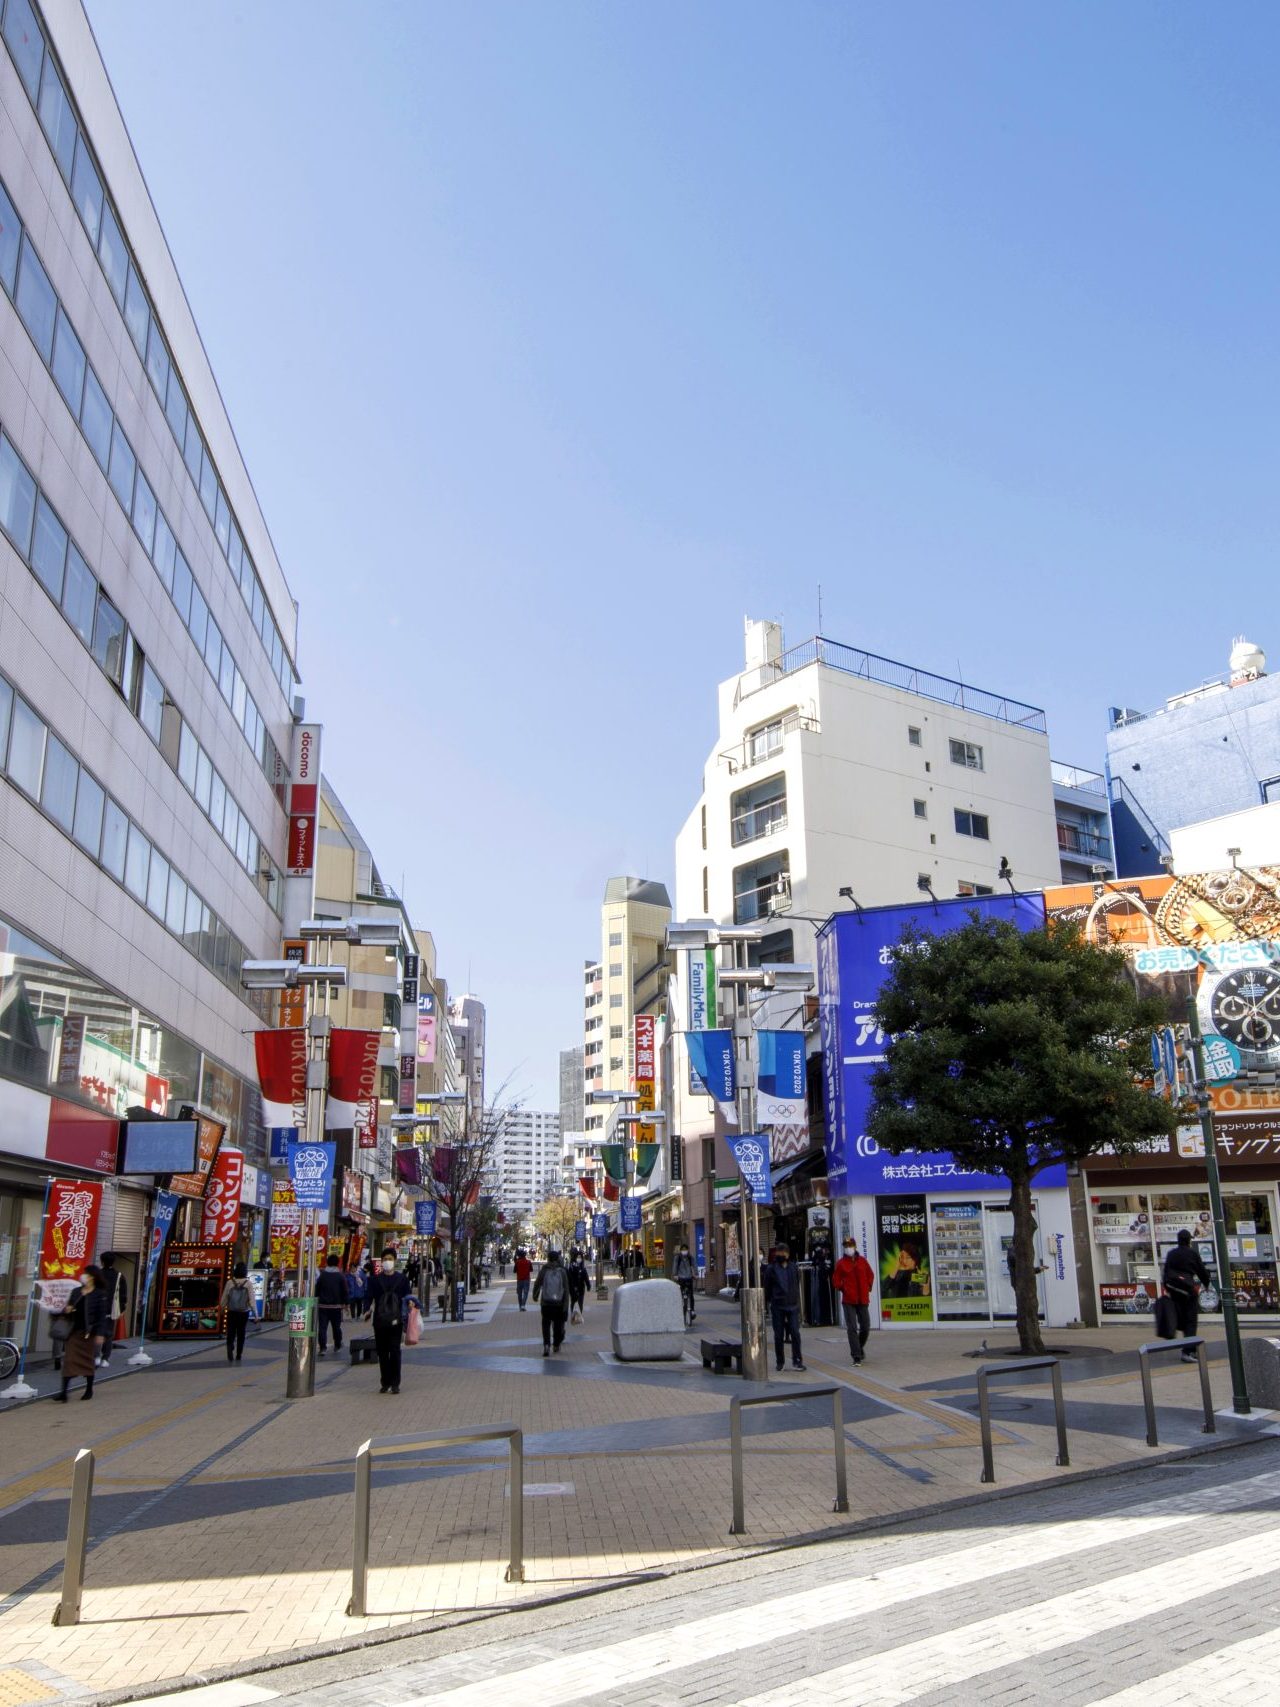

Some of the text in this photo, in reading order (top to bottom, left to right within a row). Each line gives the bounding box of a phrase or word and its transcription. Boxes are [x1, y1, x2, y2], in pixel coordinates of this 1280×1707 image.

[300, 731, 312, 778] docomo
[693, 962, 705, 1030] FamilyMart
[360, 1033, 380, 1084] TOKYO
[637, 1018, 654, 1078] スギ薬局
[793, 1049, 802, 1094] TOKYO 2020
[291, 1031, 306, 1128] TOKYO 2020
[722, 1049, 732, 1097] TOKYO 2020
[354, 1087, 372, 1128] 2020
[55, 1191, 75, 1227] フェア
[66, 1191, 93, 1258] 家計相談
[1056, 1233, 1065, 1280] Apamanshop
